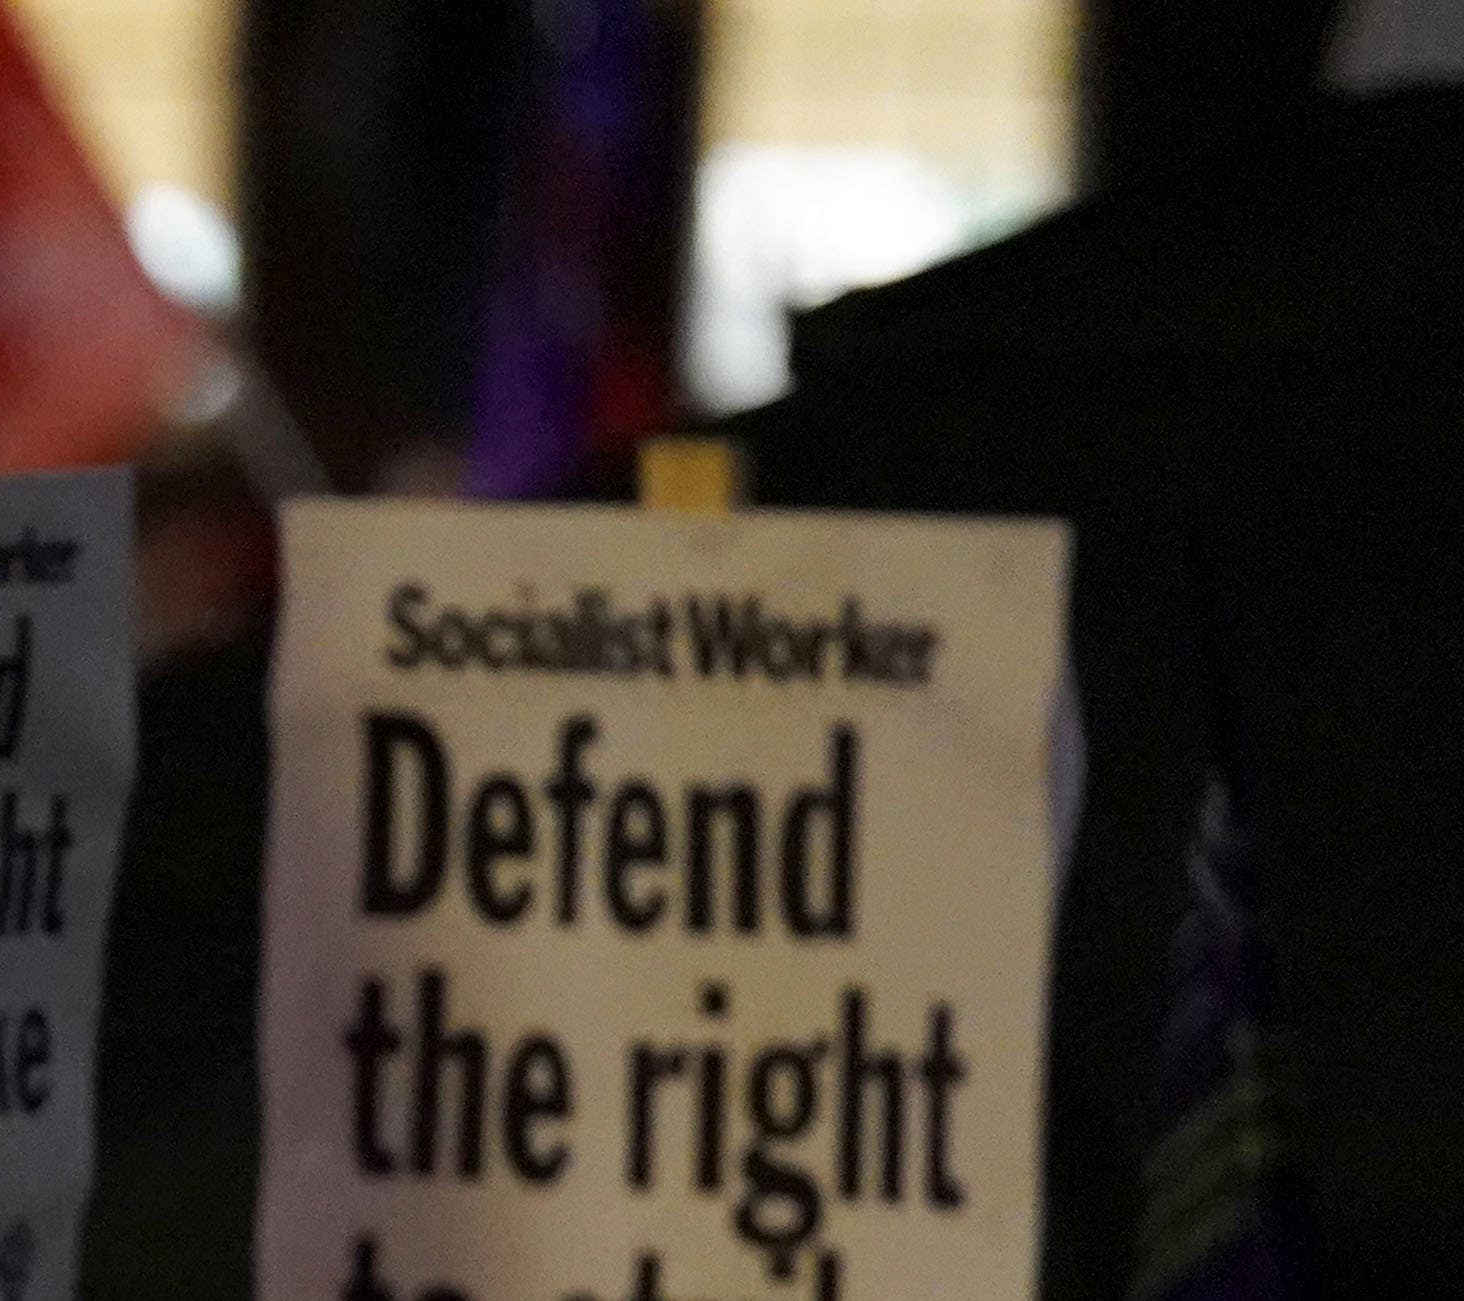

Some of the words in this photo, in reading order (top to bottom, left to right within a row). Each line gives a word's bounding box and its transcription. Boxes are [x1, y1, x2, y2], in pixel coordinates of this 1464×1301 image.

[359, 707, 858, 942] Defend
[342, 964, 574, 1188] the
[626, 980, 969, 1252] right
